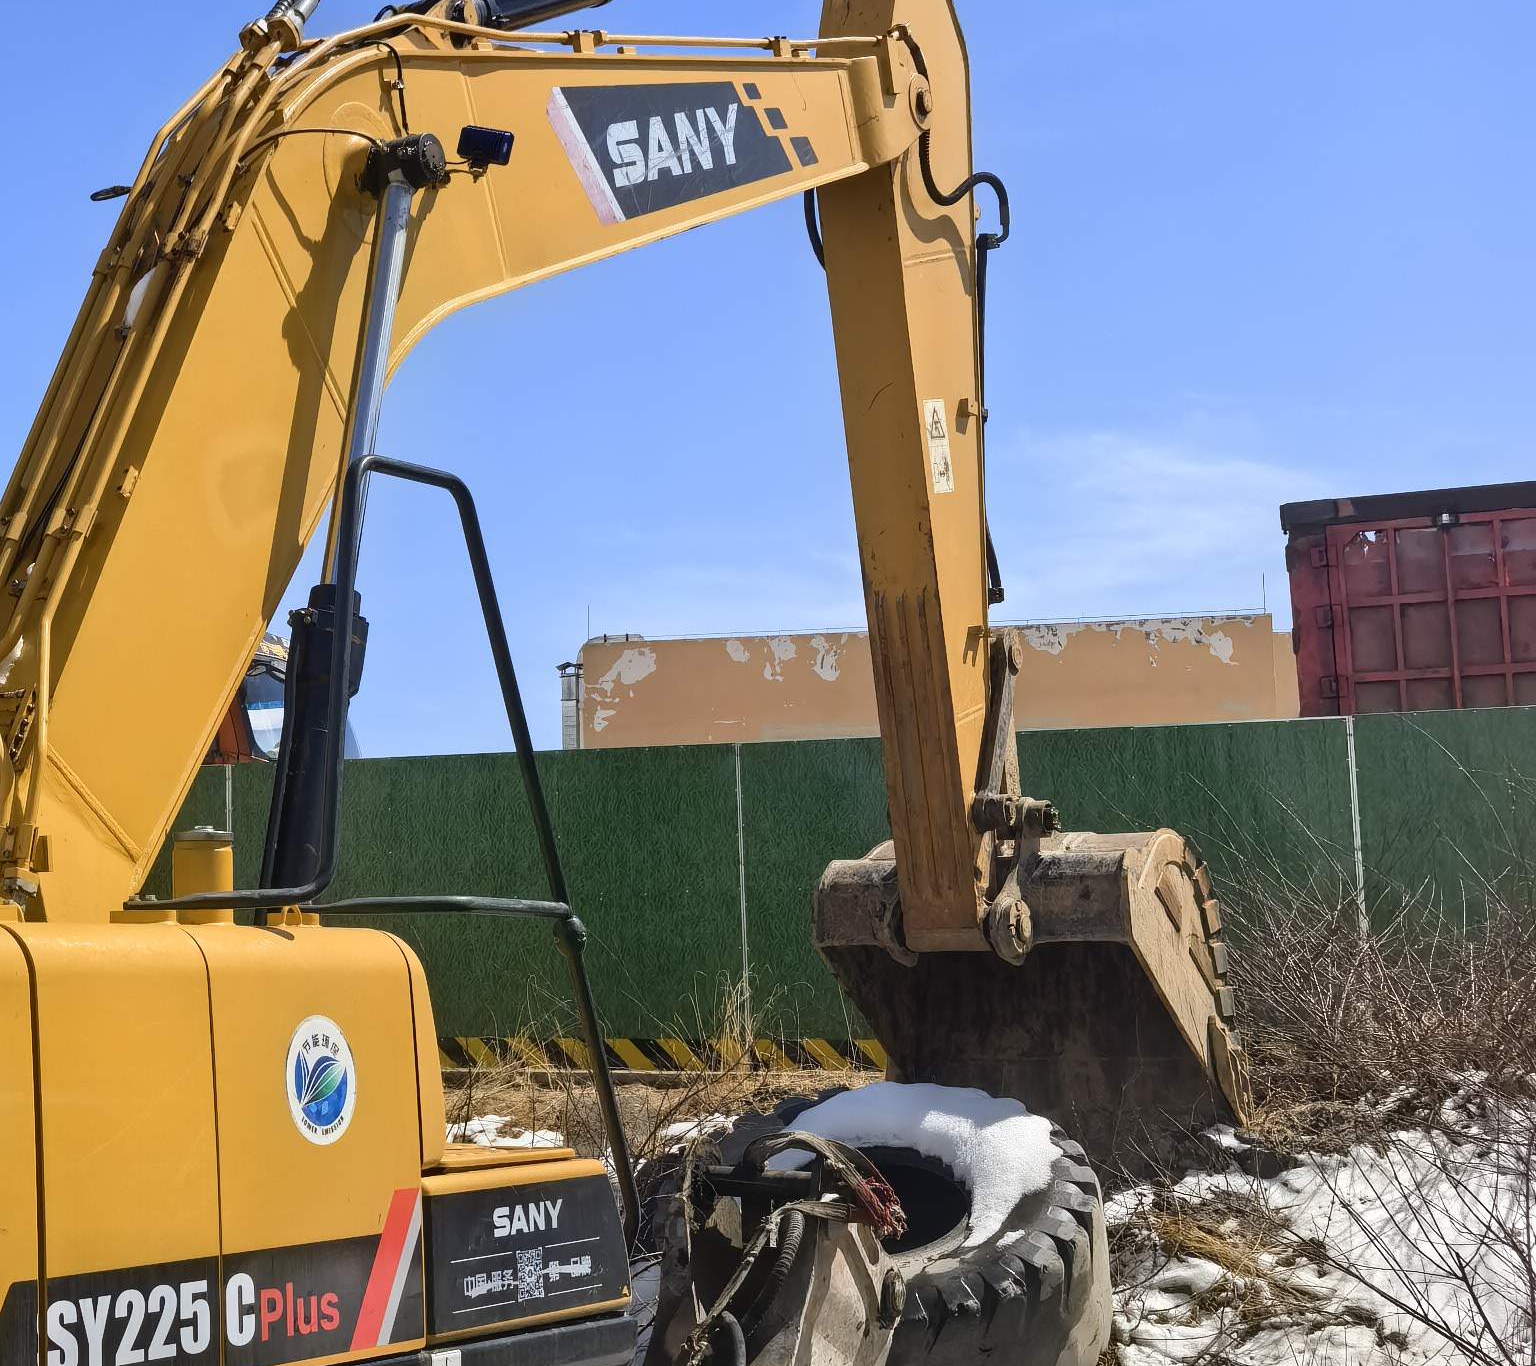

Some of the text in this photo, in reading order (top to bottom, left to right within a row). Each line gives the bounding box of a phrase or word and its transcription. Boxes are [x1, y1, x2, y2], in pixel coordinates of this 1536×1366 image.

[606, 103, 738, 188] SANY
[493, 1199, 563, 1237] SANY
[226, 1272, 256, 1347] C
[260, 1281, 340, 1343] Plus
